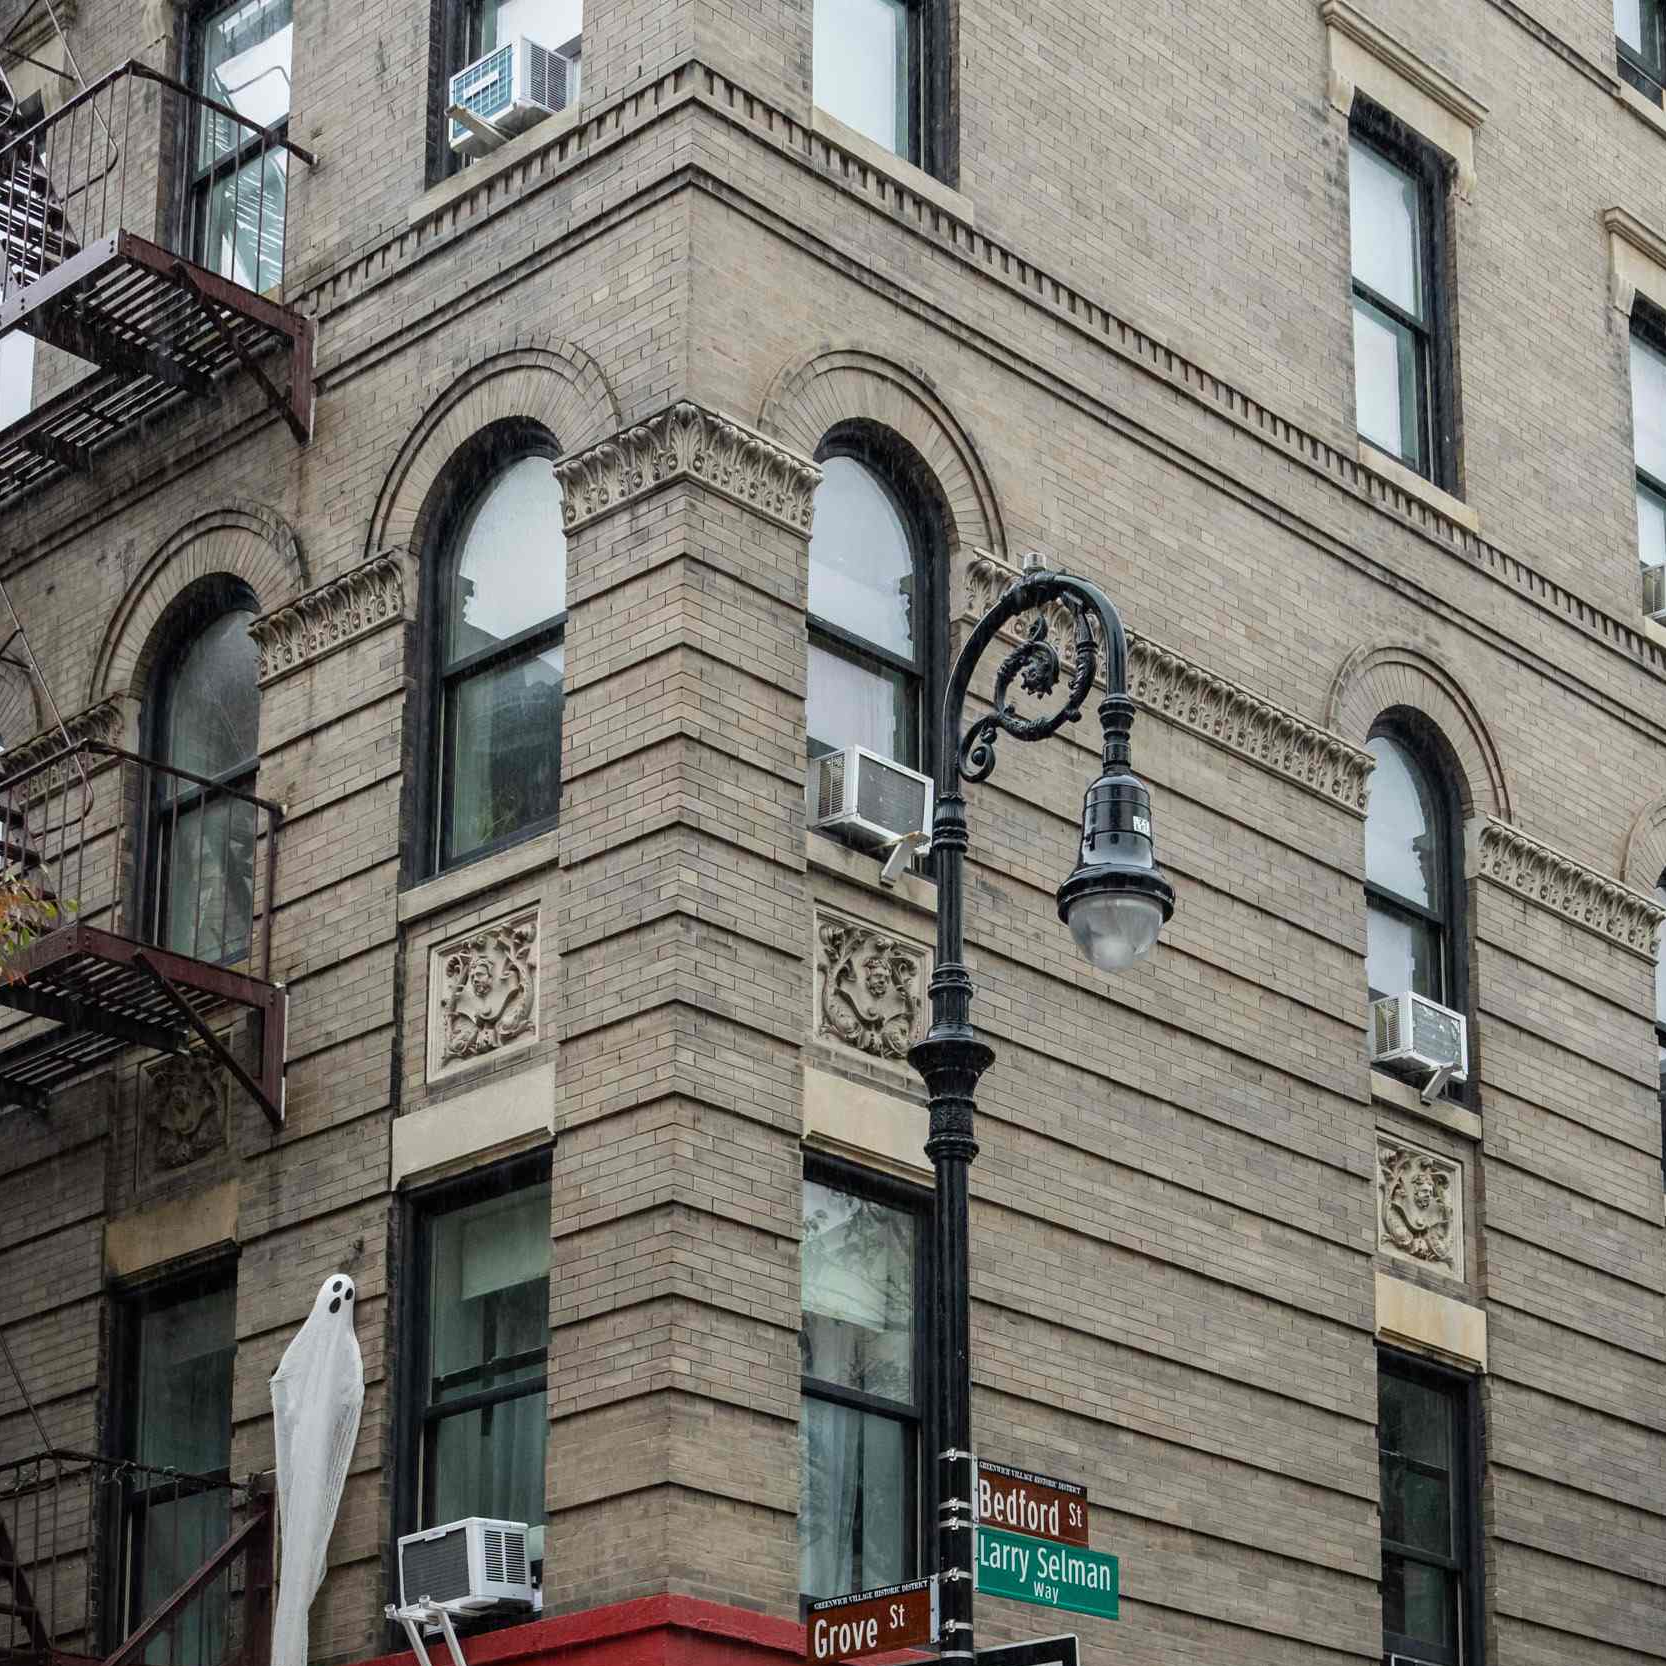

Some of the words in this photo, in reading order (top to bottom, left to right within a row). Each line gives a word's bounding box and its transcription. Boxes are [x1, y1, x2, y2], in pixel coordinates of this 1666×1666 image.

[1011, 1468, 1033, 1483] VILLAGE
[978, 1478, 1060, 1536] Bedford
[1068, 1502, 1083, 1528] St
[980, 1534, 1030, 1583] Larry
[1037, 1547, 1111, 1591] Selman
[849, 1592, 874, 1604] VILLAGE
[874, 1586, 900, 1599] HISTORIC
[1033, 1580, 1059, 1605] Way
[814, 1618, 878, 1659] Grove
[889, 1603, 906, 1630] St
